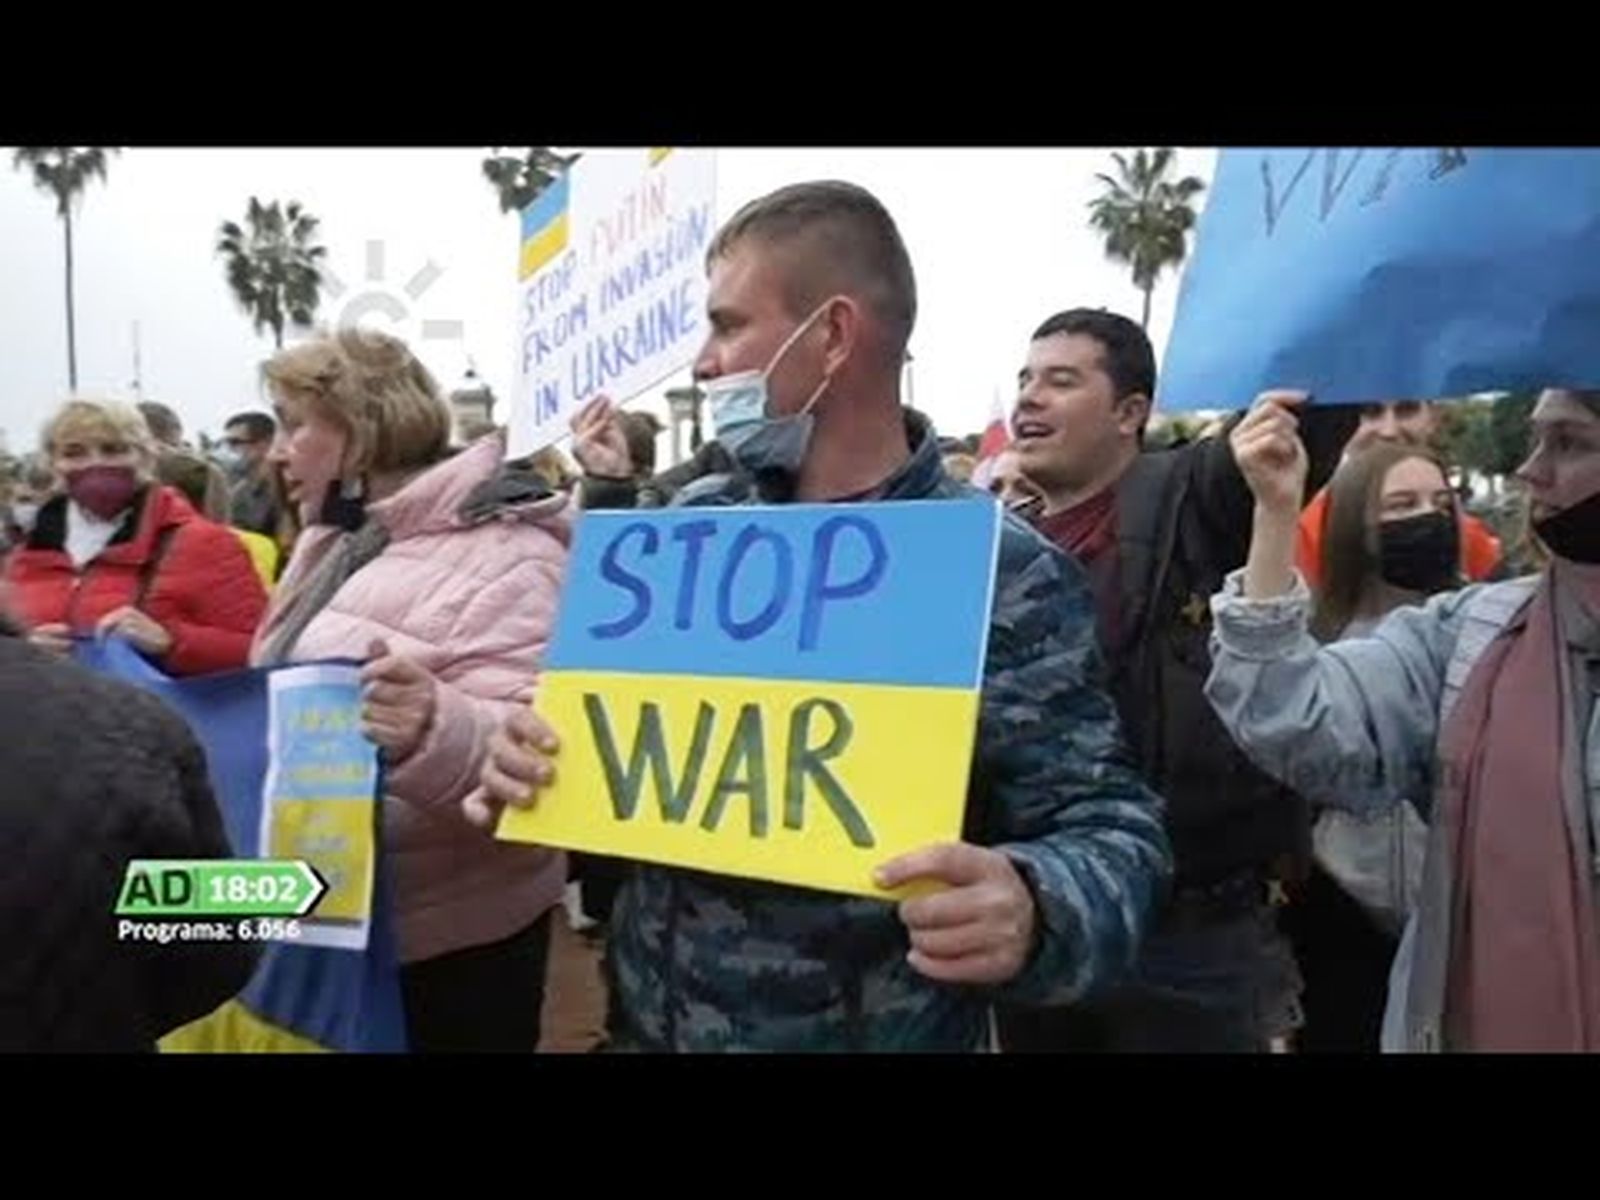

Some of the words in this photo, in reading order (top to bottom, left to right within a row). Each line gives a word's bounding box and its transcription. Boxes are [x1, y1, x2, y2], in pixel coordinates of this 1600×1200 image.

[523, 294, 588, 374] FROM
[525, 249, 577, 325] STOP
[573, 278, 698, 400] UKRAINE
[588, 514, 889, 651] STOP
[583, 692, 875, 849] WAR
